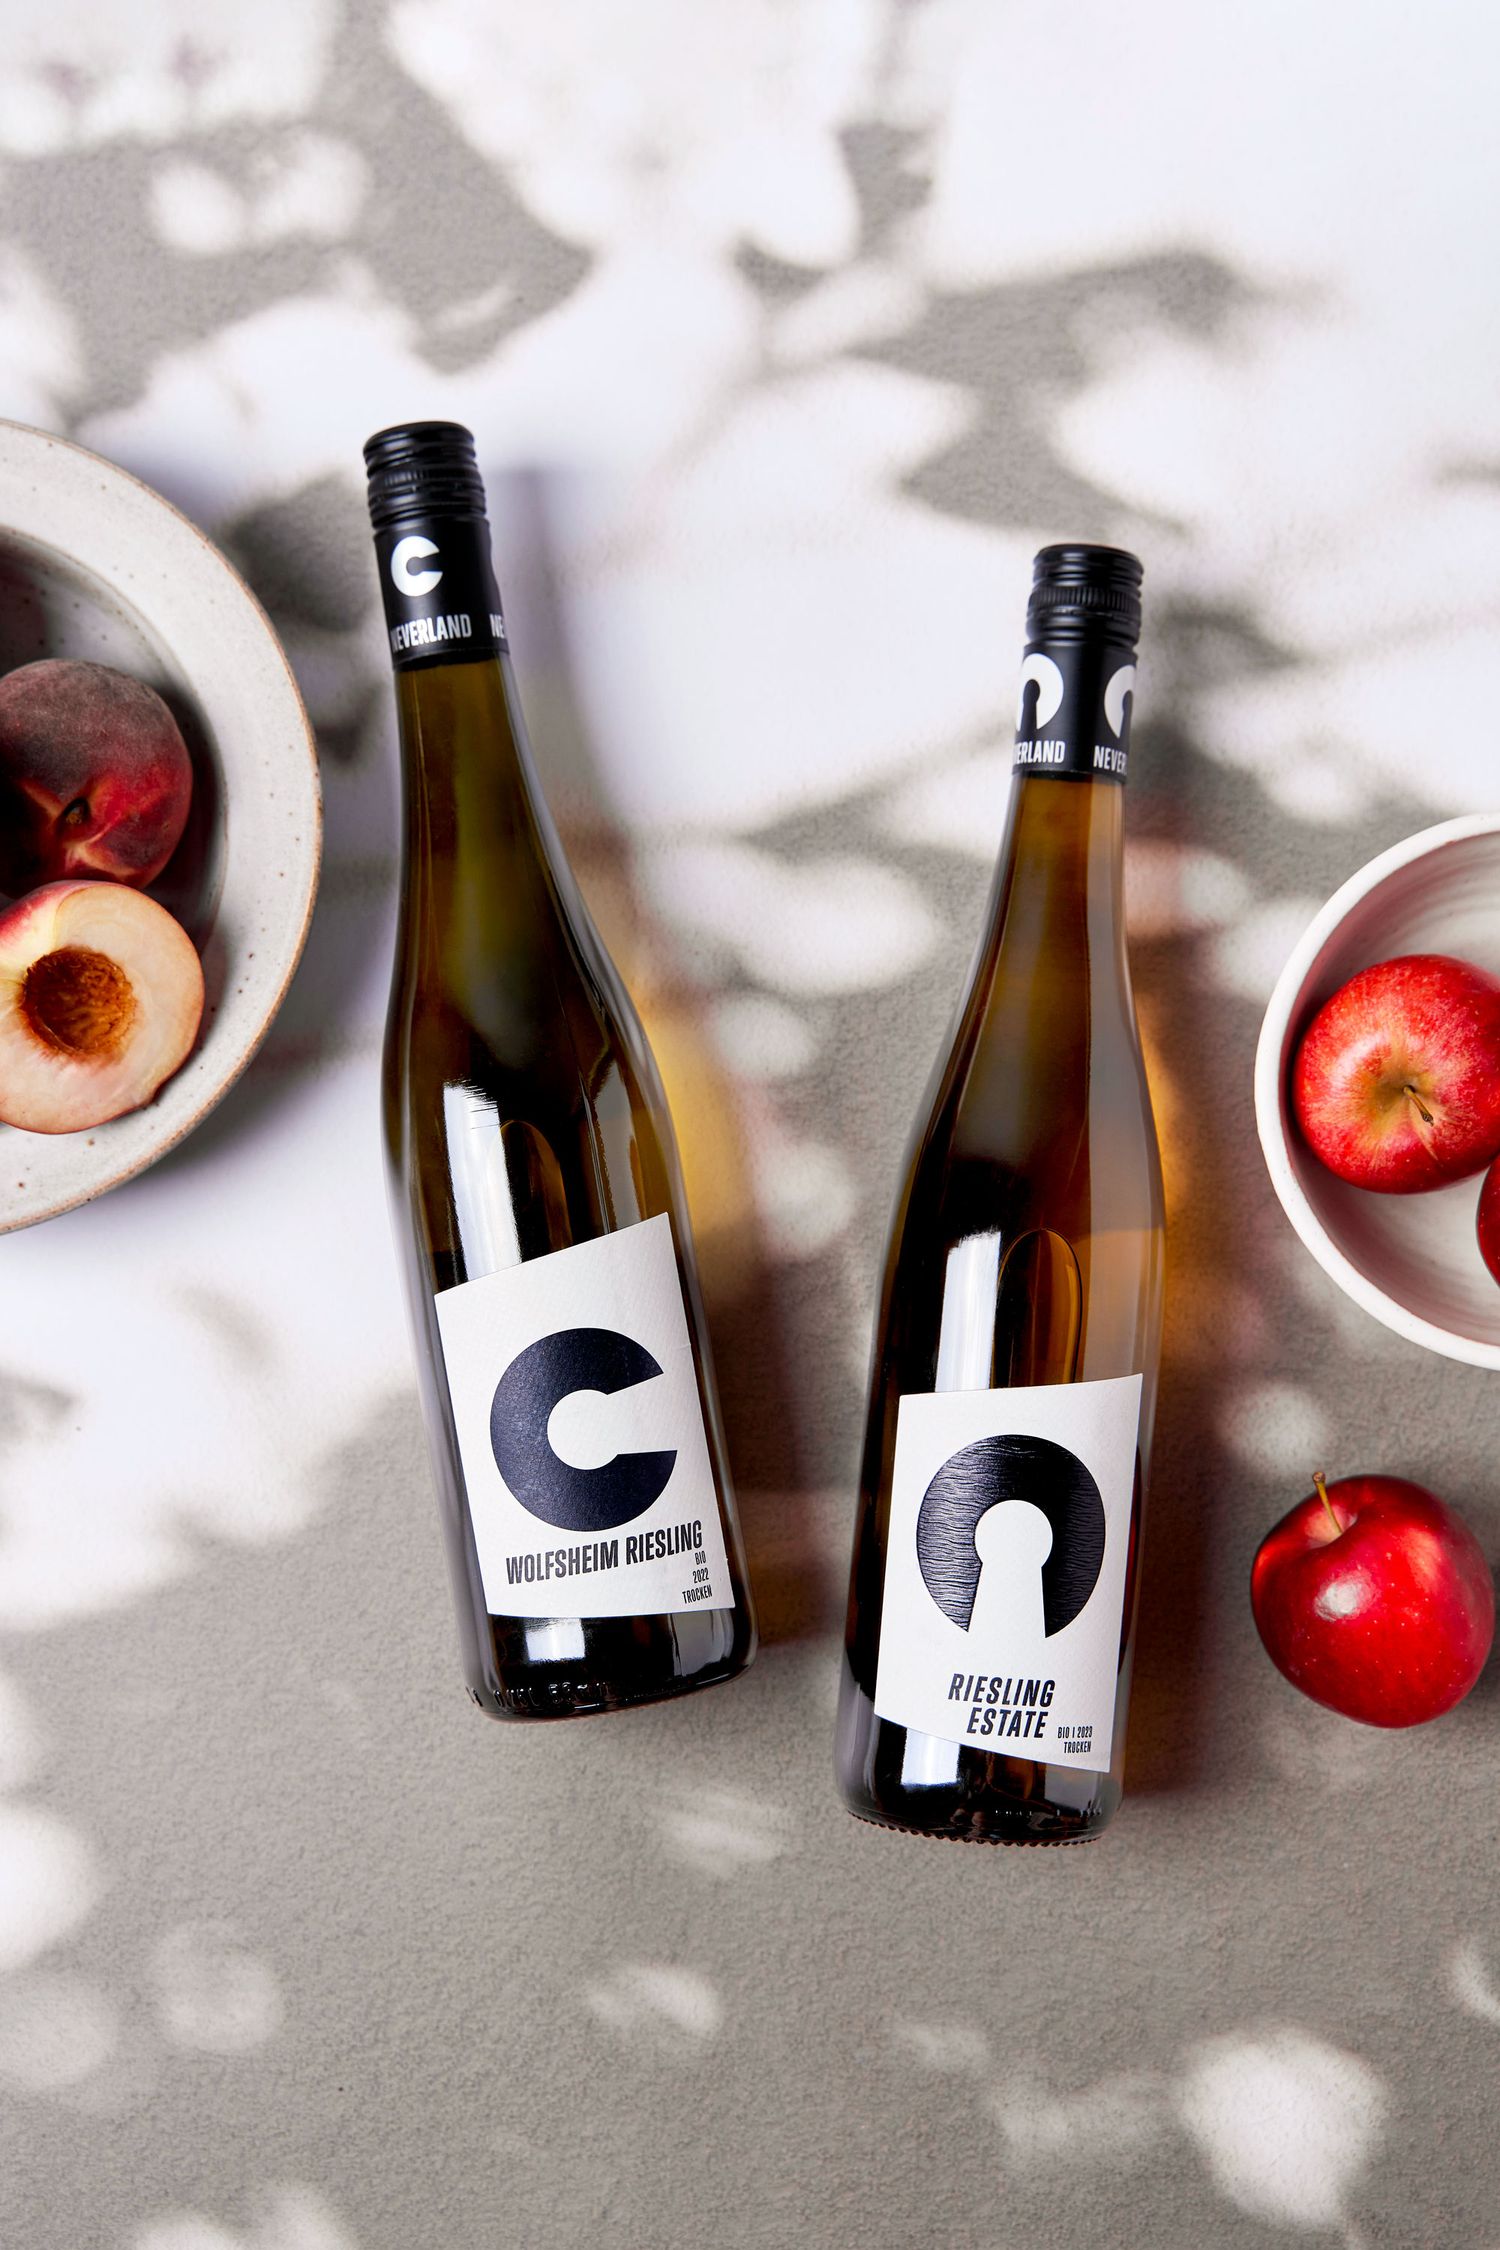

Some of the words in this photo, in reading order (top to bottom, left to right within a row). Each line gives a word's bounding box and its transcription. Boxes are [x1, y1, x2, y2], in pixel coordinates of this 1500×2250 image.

[506, 1539, 619, 1585] WOLFSHEIM
[625, 1519, 702, 1565] RIESLING
[694, 1550, 707, 1566] BIO
[692, 1567, 709, 1584] 2022
[682, 1584, 713, 1604] TROCKEN
[948, 1673, 1056, 1708] RIESLING
[966, 1706, 1049, 1739] ESTATE
[1057, 1726, 1070, 1739] BIO
[1076, 1725, 1093, 1739] 2023
[1063, 1740, 1091, 1754] TROCKEN
